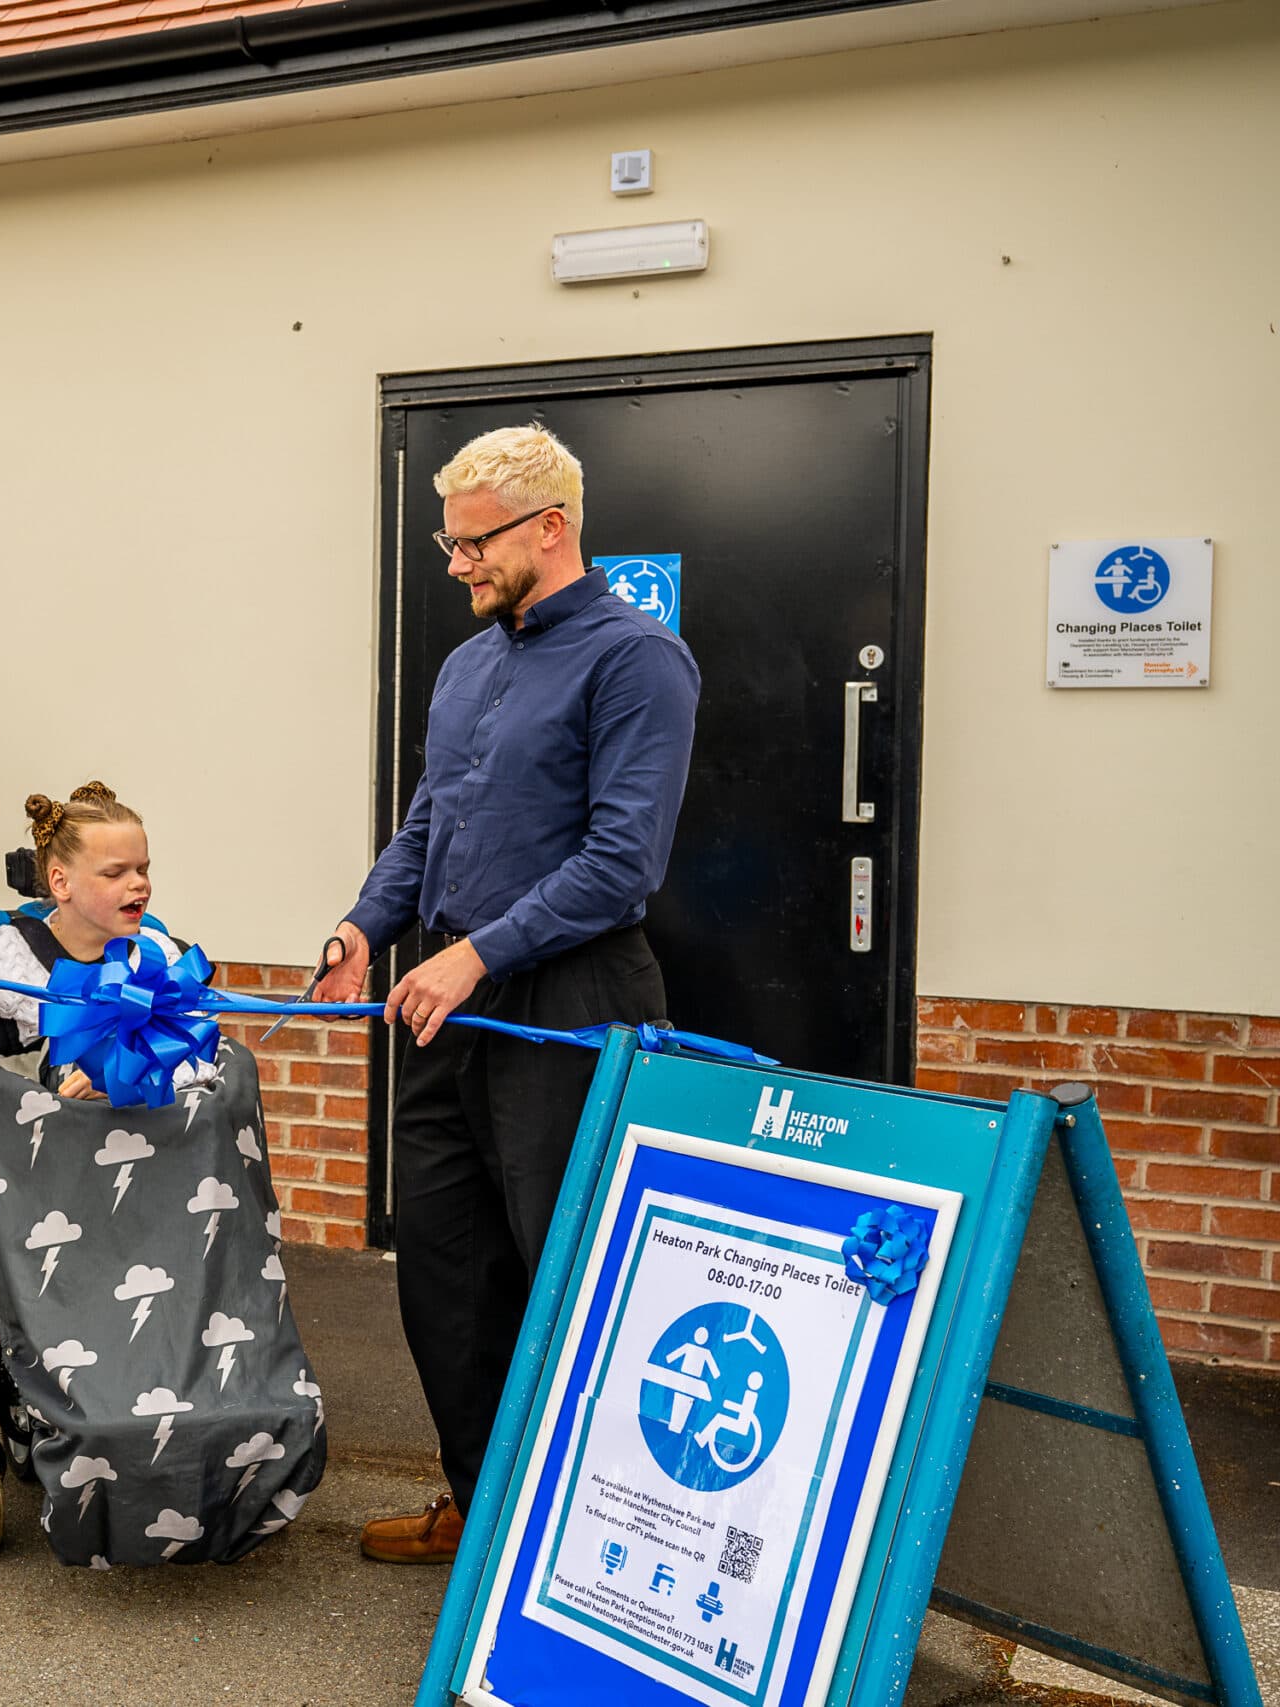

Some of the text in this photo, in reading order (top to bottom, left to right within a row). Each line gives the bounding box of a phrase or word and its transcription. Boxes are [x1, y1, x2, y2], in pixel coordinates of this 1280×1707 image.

[1056, 621, 1202, 635] Changing Places Toilet
[784, 1126, 825, 1148] PARK
[789, 1110, 849, 1135] HEATON
[653, 1229, 861, 1296] Heaton Park Changing Places Toilet
[707, 1268, 782, 1300] 08:00-17:00
[591, 1474, 716, 1529] Also available at Wythenshawe Park and
[600, 1487, 702, 1536] 5 other Manchester City Council
[585, 1504, 593, 1515] To
[594, 1508, 607, 1521] find
[607, 1516, 625, 1528] other
[644, 1532, 664, 1545] please
[665, 1541, 680, 1551] scan
[681, 1547, 693, 1557] the
[693, 1551, 706, 1562] QR
[634, 1515, 657, 1530] venues.
[555, 1573, 714, 1654] Please call Heaton Park reception on 0161 773 1085
[596, 1581, 629, 1603] Comments
[638, 1601, 675, 1623] Questions?
[574, 1597, 592, 1609] email
[592, 1603, 694, 1658] heatonpark@manchester.gov.uk
[732, 1669, 744, 1679] HALL
[735, 1657, 755, 1671] HEATON
